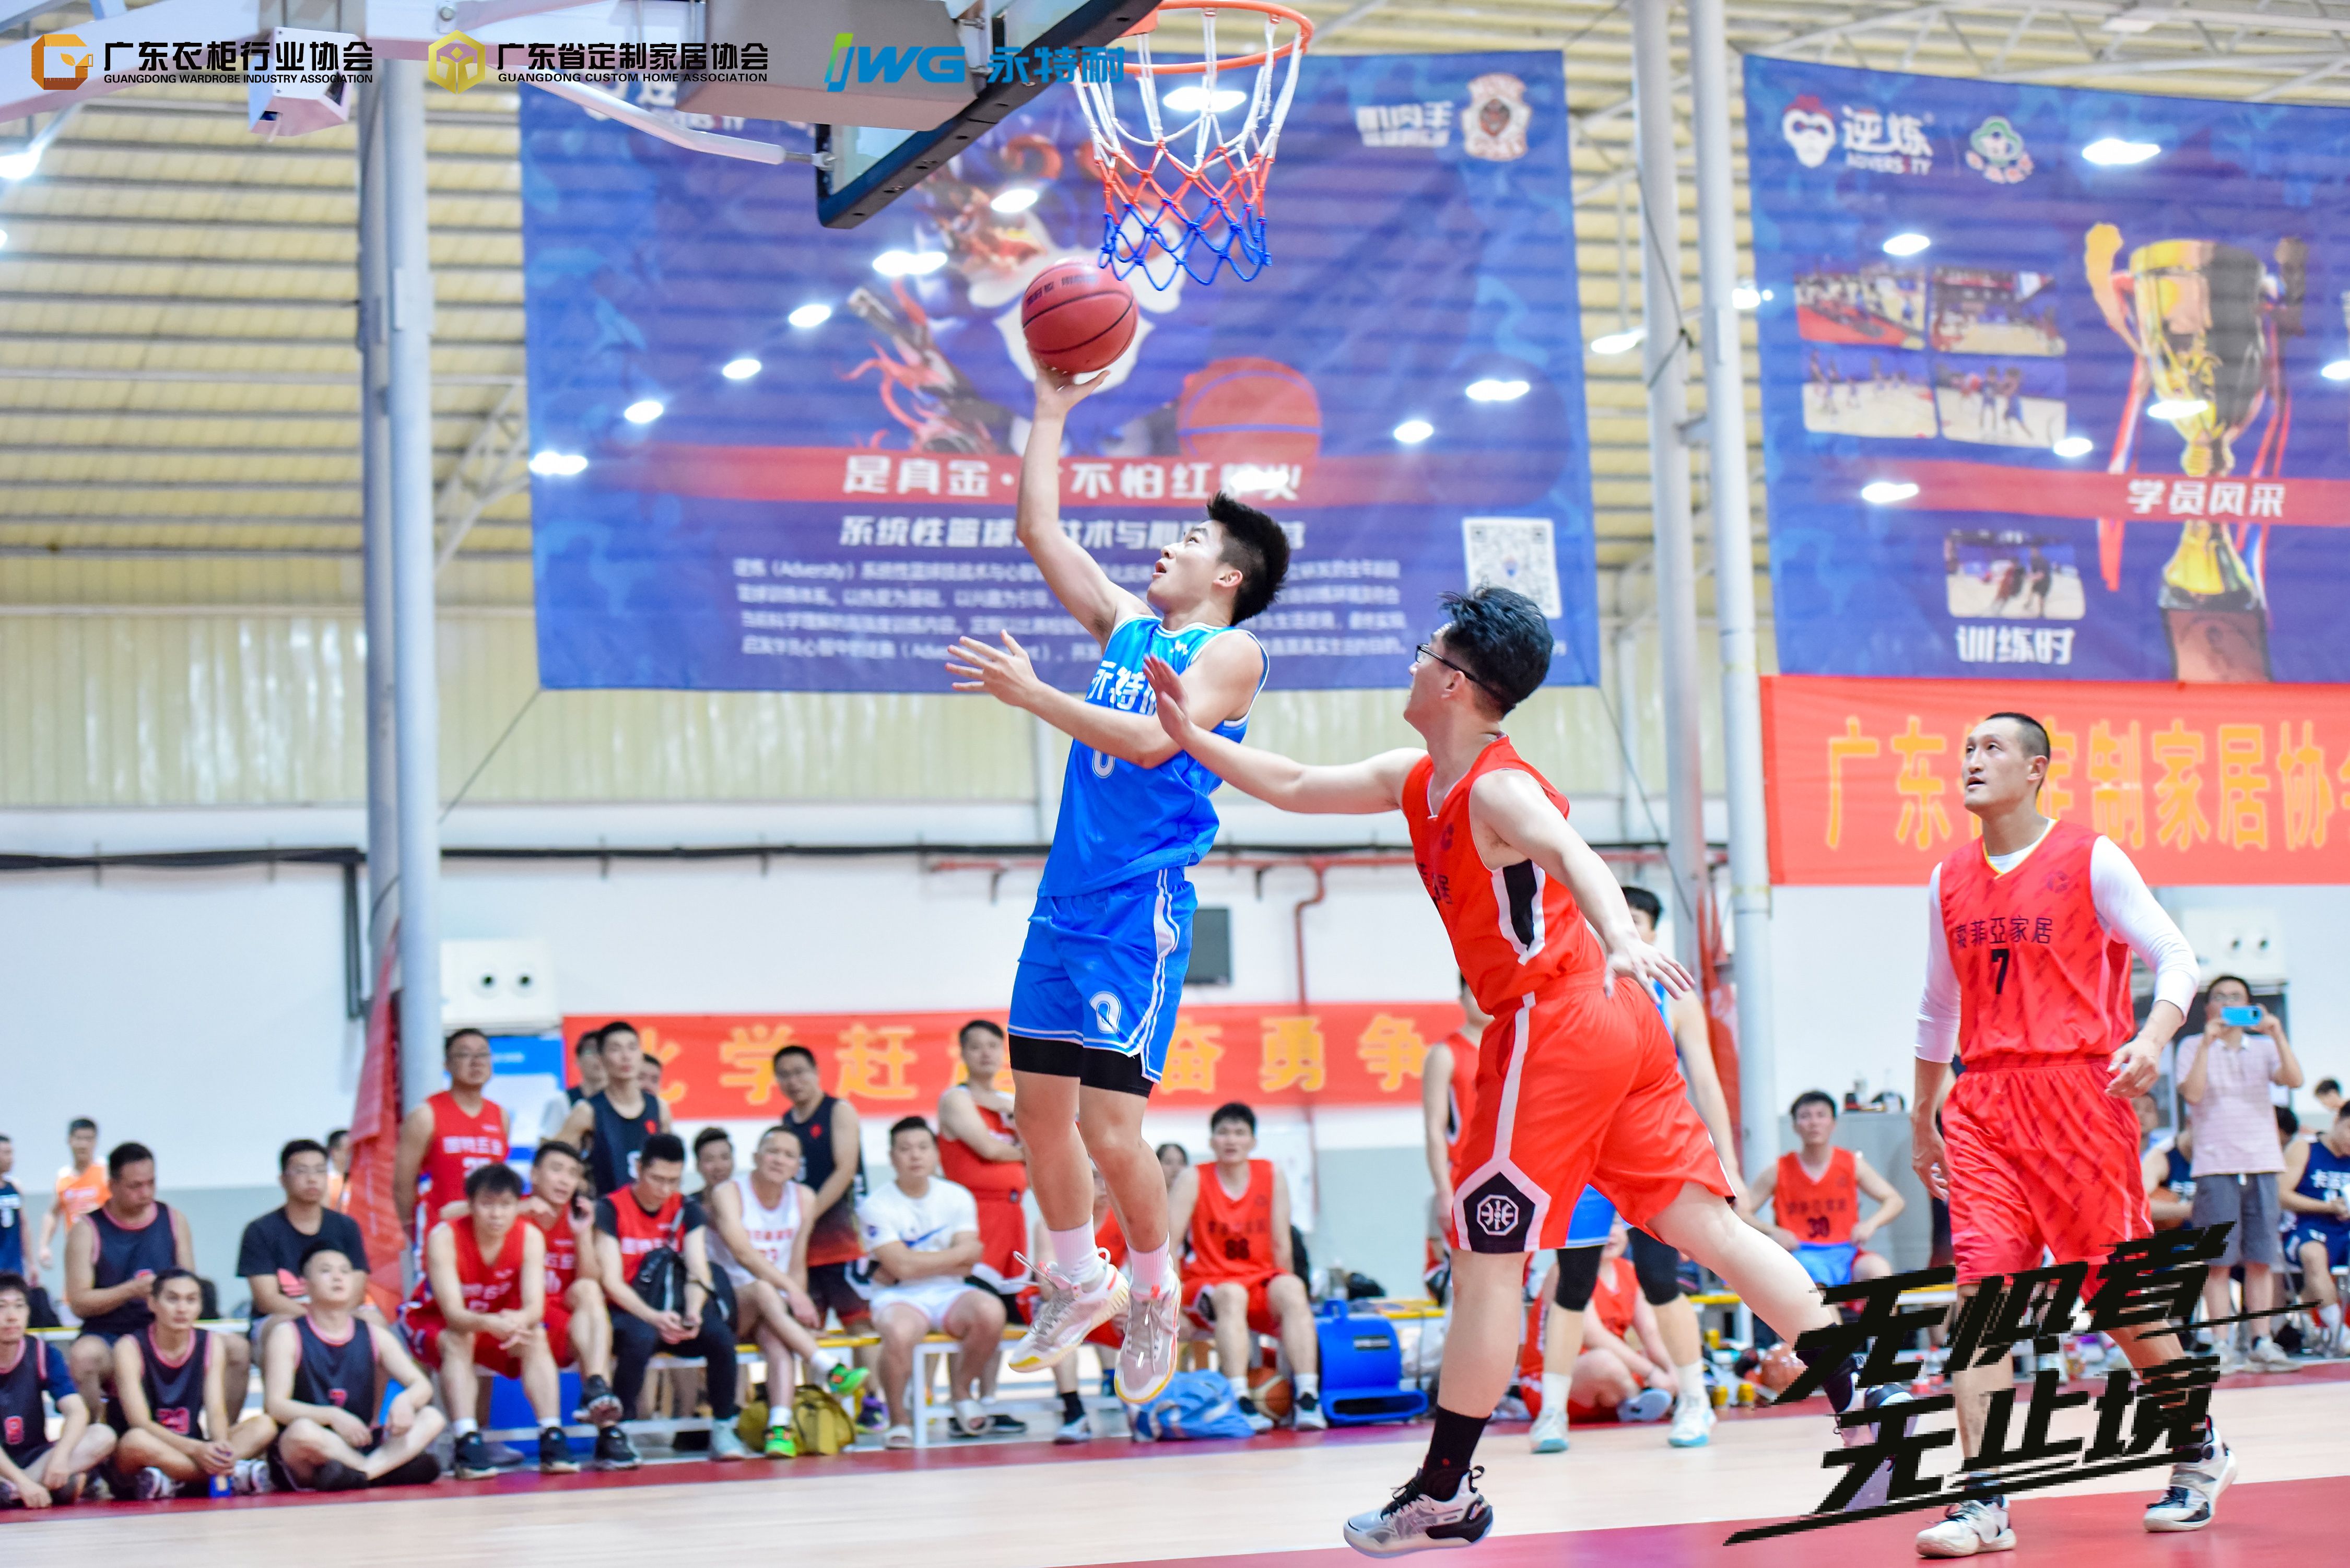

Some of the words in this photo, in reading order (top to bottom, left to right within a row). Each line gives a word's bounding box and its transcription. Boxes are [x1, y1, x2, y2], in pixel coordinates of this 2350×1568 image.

[2127, 479, 2286, 518] 学员风采
[1956, 625, 2075, 666] 训练时
[1991, 948, 2010, 994] 7
